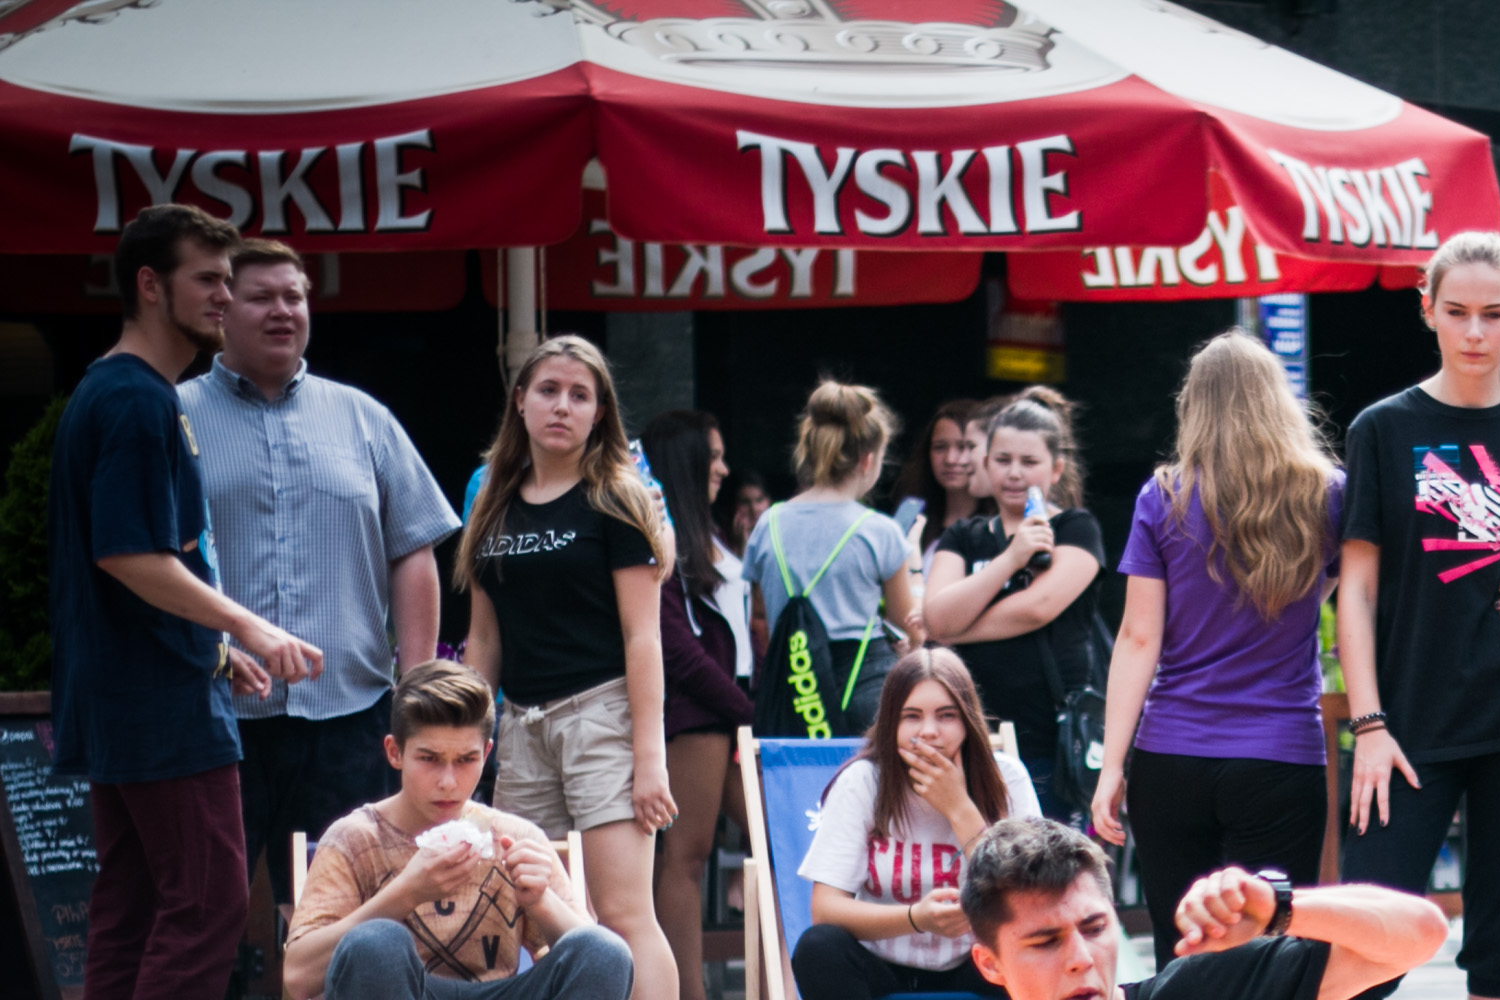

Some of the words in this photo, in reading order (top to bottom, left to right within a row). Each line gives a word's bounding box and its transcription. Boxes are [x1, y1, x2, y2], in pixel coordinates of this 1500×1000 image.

[69, 128, 434, 235] TYSKIE
[736, 129, 1082, 238] TYSKIE
[1267, 148, 1440, 250] TYSKIE
[787, 629, 832, 740] adidas
